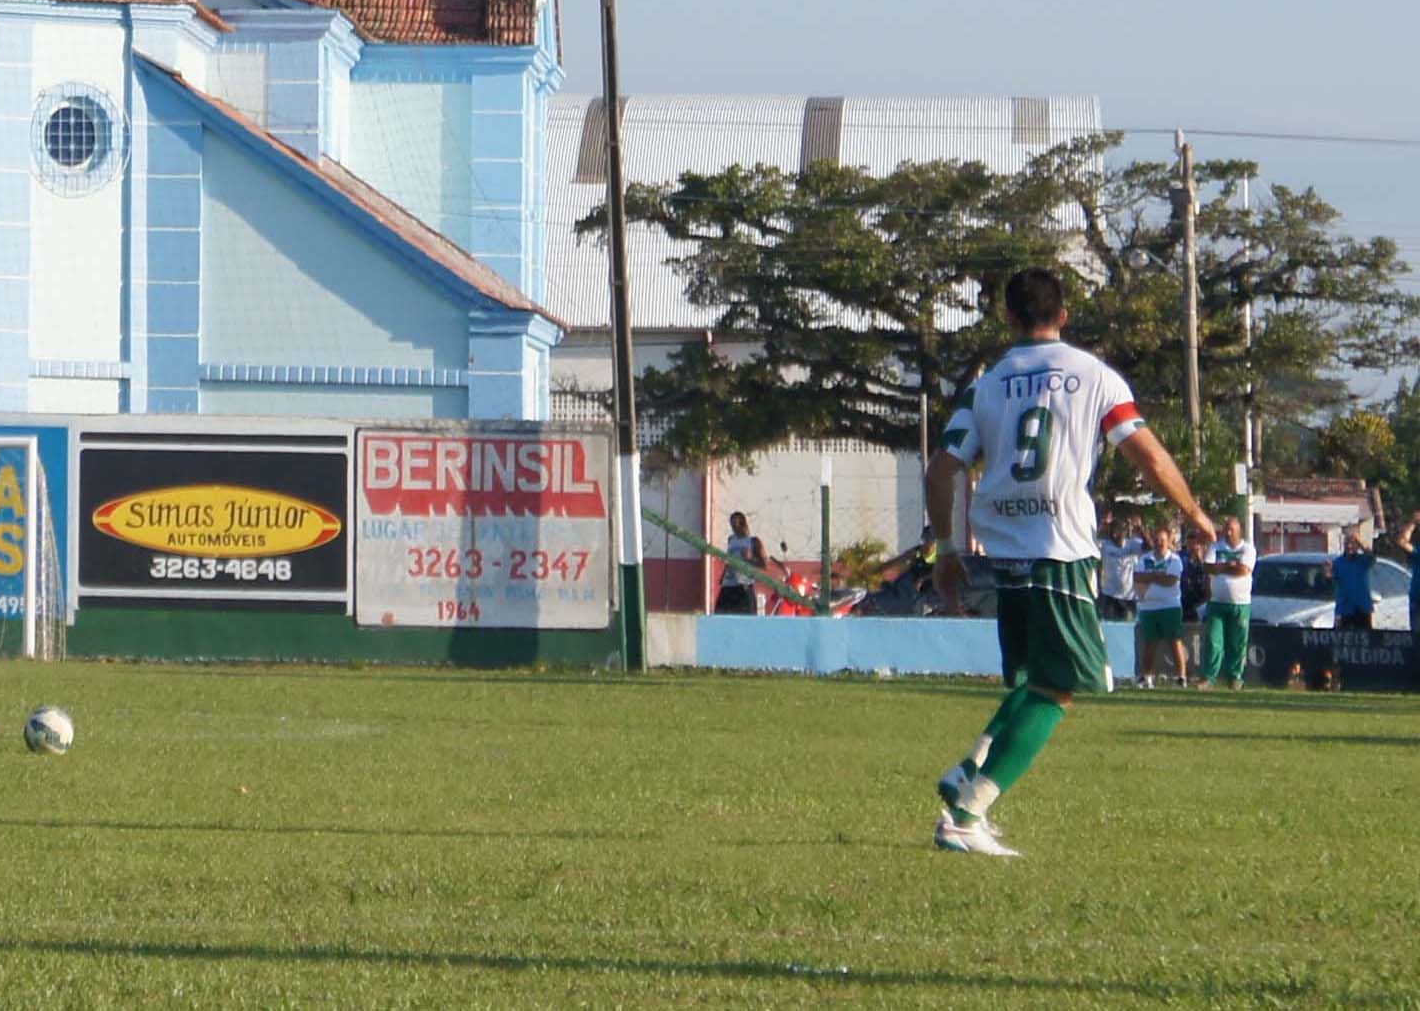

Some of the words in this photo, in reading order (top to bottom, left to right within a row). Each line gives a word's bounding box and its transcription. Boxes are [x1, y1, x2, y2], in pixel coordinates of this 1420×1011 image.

[1010, 405, 1054, 483] 9
[366, 439, 596, 494] BERINSIL
[125, 499, 215, 529] Simas
[220, 498, 311, 537] Júnior
[150, 557, 292, 581] 3263-4848
[436, 600, 481, 622] 1964
